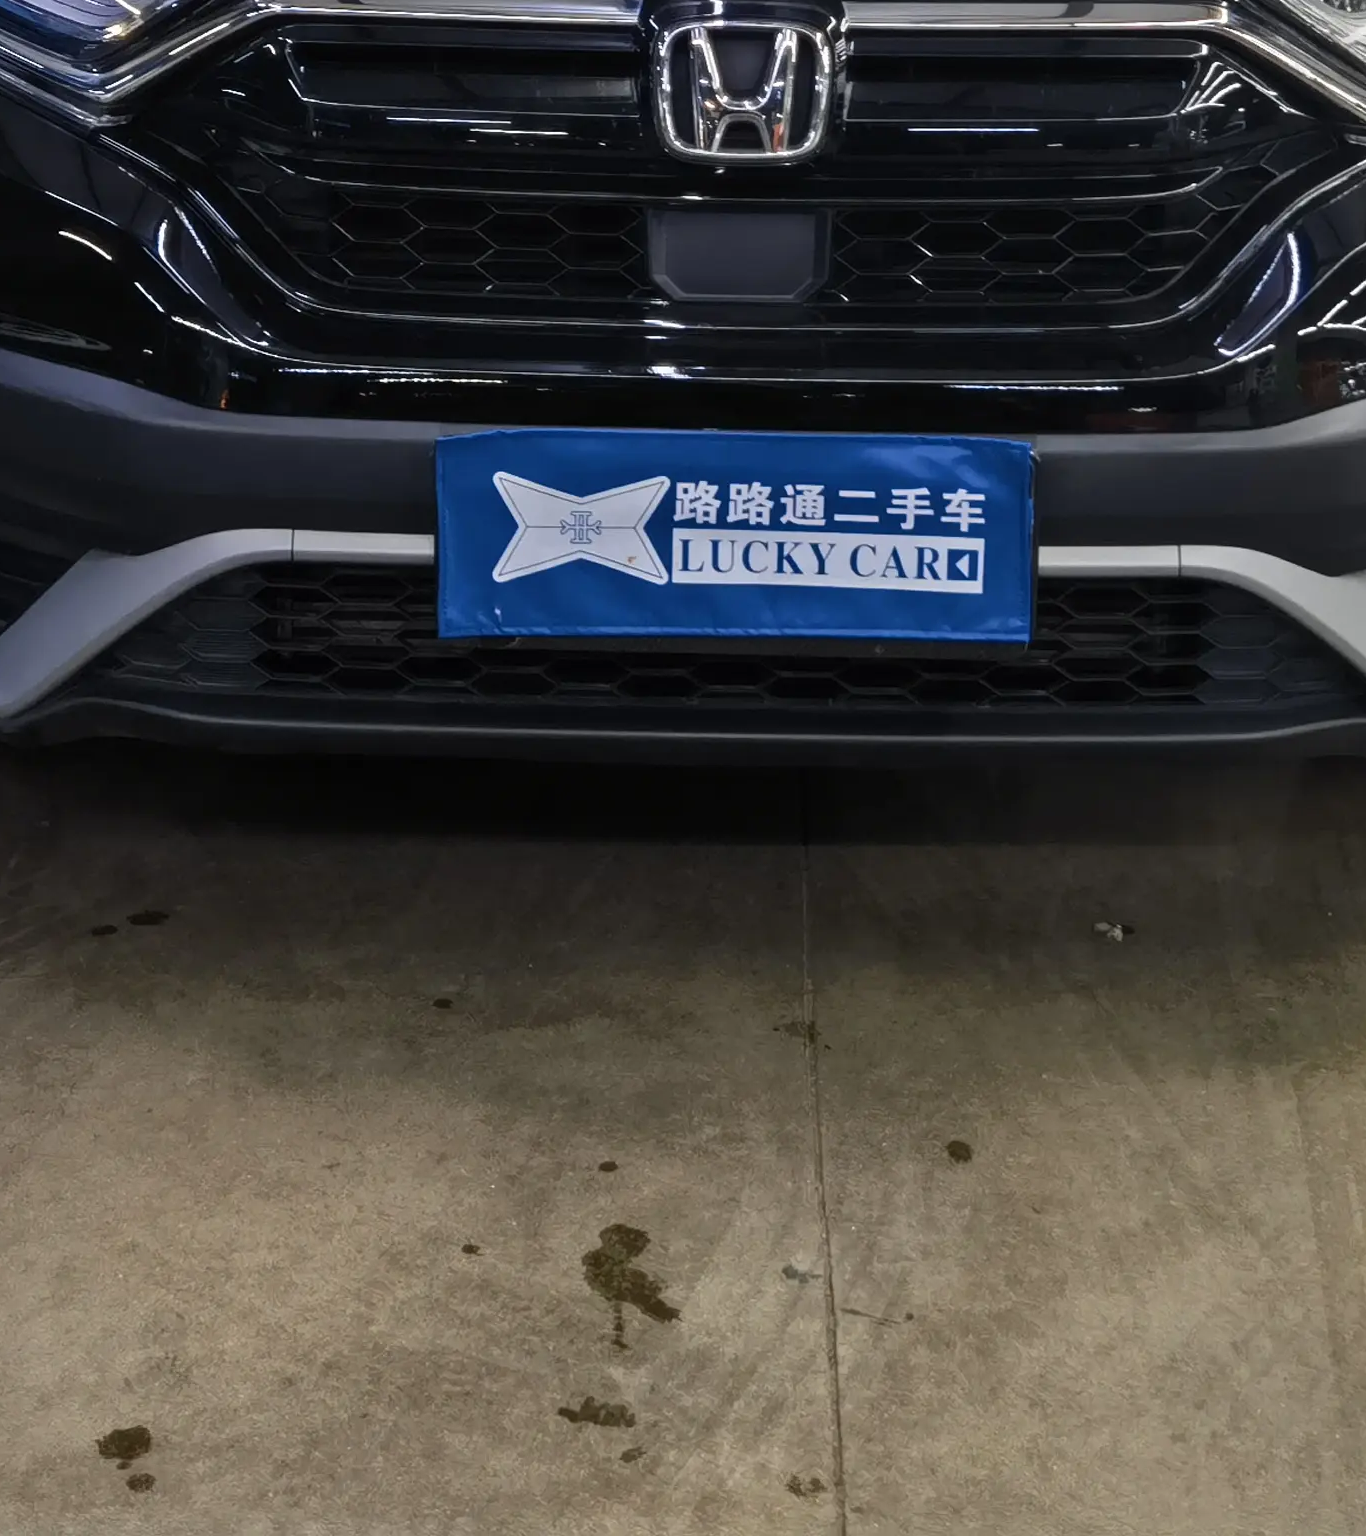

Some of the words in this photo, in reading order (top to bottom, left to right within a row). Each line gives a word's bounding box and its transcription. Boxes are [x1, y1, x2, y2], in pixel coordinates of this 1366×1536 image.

[673, 480, 986, 532] 路路通二手车
[678, 538, 836, 576] LUCKY
[849, 543, 942, 581] CAR
